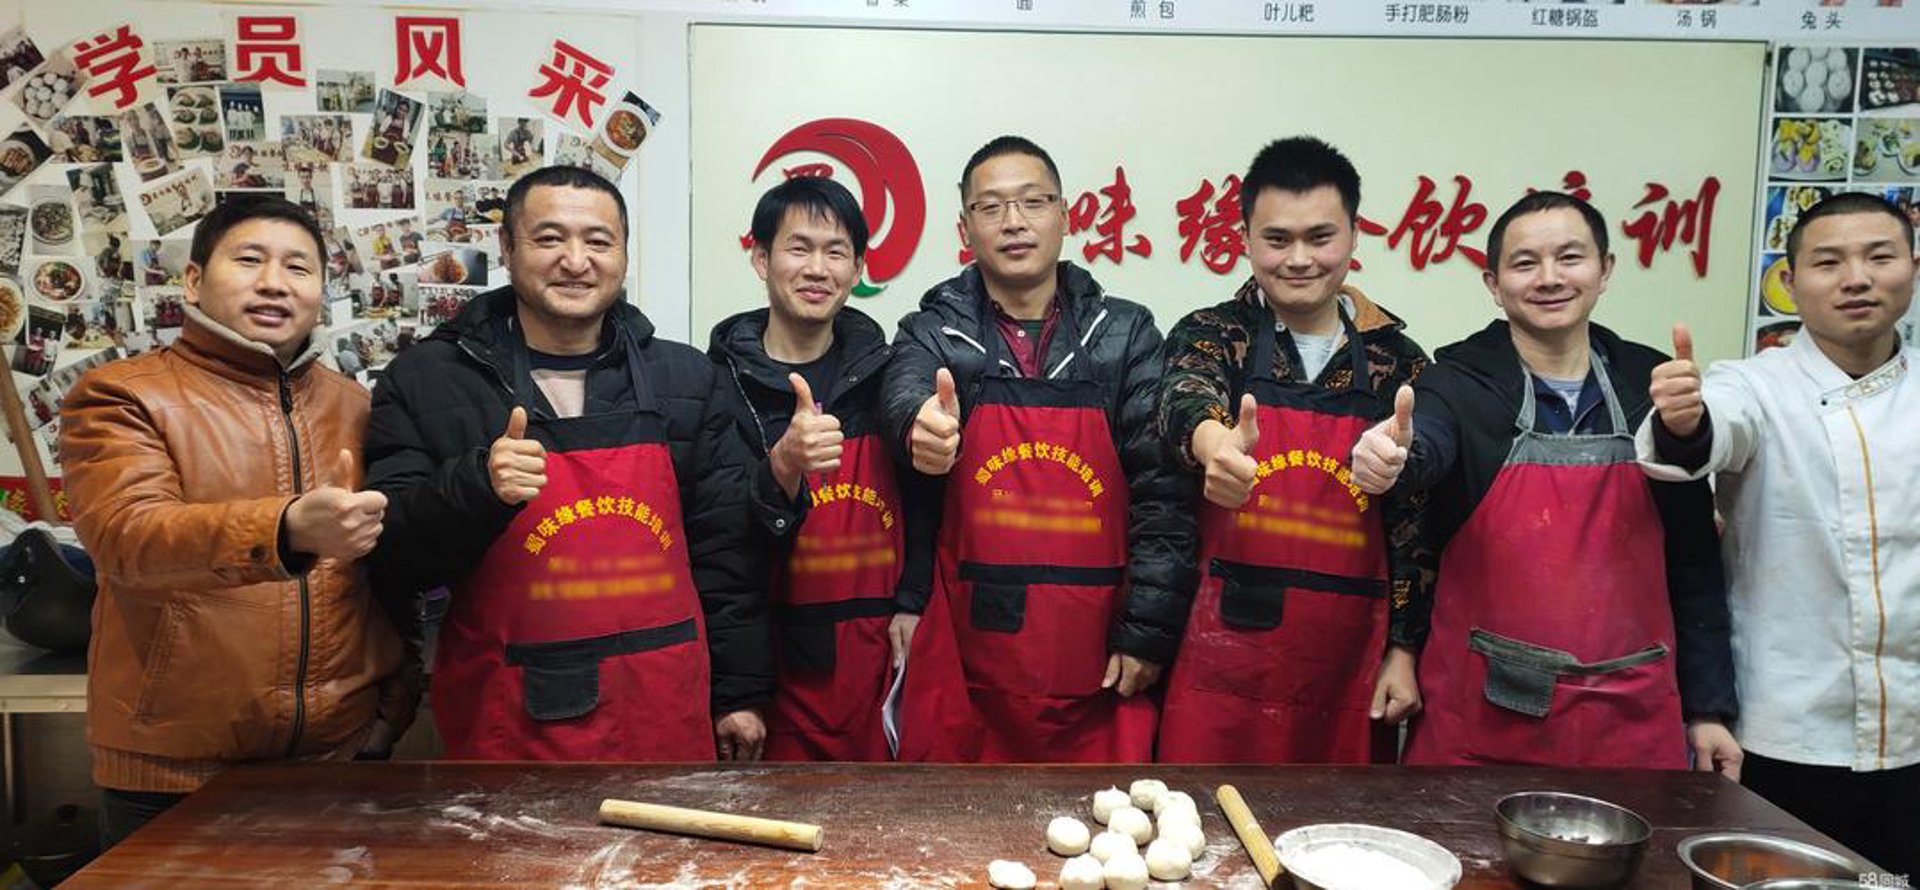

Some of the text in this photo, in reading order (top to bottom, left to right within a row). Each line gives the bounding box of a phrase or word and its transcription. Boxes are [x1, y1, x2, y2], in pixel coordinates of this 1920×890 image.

[1130, 1, 1175, 19] 煎包
[1264, 4, 1315, 22] 叶儿粑
[1385, 4, 1470, 24] 手打肥肠粉
[1532, 8, 1599, 27] 红糖锅盔
[1677, 10, 1717, 28] 汤锅
[1801, 11, 1842, 30] 兔头
[73, 16, 616, 129] 学员风采
[524, 496, 673, 554] 蜀味缘餐饮技能培训
